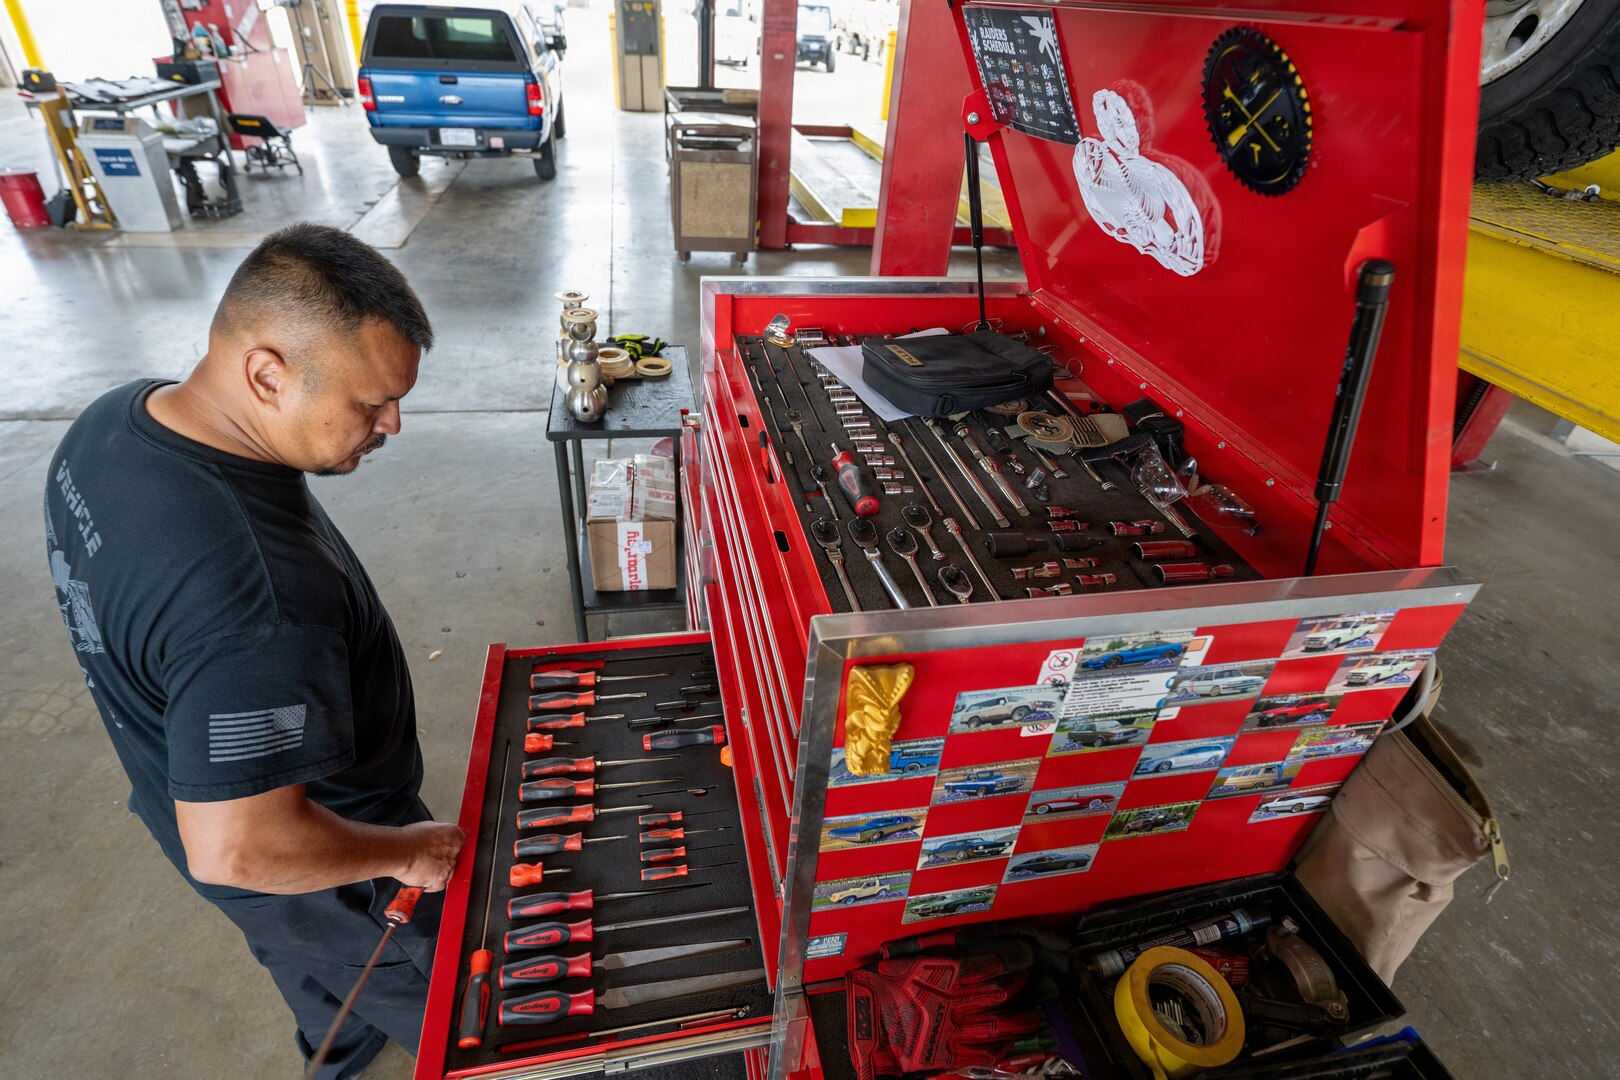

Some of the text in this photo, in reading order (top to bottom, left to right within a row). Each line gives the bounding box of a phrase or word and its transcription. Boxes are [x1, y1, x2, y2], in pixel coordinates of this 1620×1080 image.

[979, 26, 1008, 42] RAIDERS
[982, 39, 1016, 55] SCHEDULE
[519, 967, 550, 977] Snap-on
[520, 1002, 552, 1011] Snap-on
